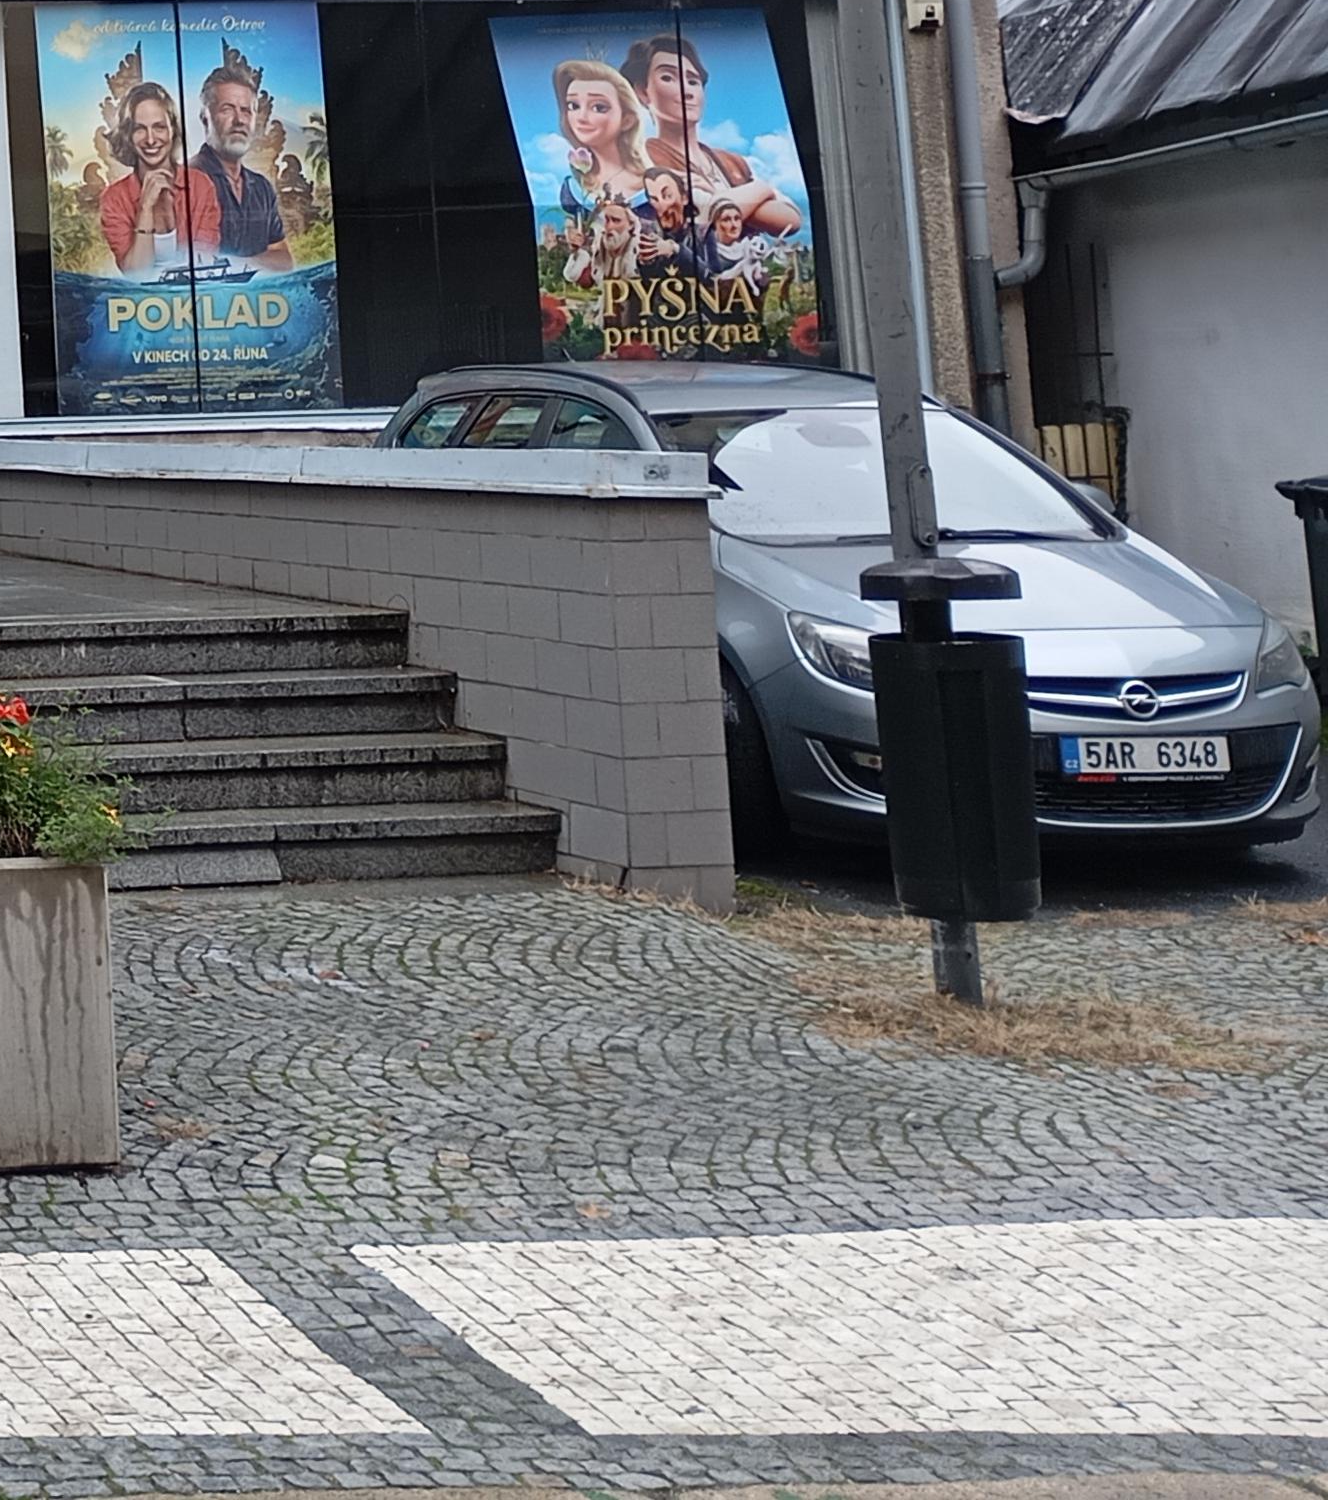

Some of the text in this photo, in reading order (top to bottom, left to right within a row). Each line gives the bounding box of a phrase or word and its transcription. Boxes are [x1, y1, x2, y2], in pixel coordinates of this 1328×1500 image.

[222, 15, 266, 32] Ostrov
[107, 292, 290, 332] POKLAD
[132, 351, 142, 364] V
[144, 349, 189, 363] KINECH
[212, 348, 231, 361] 24.
[1085, 741, 1218, 769] 5AR 6348
[1065, 760, 1078, 768] CZ
